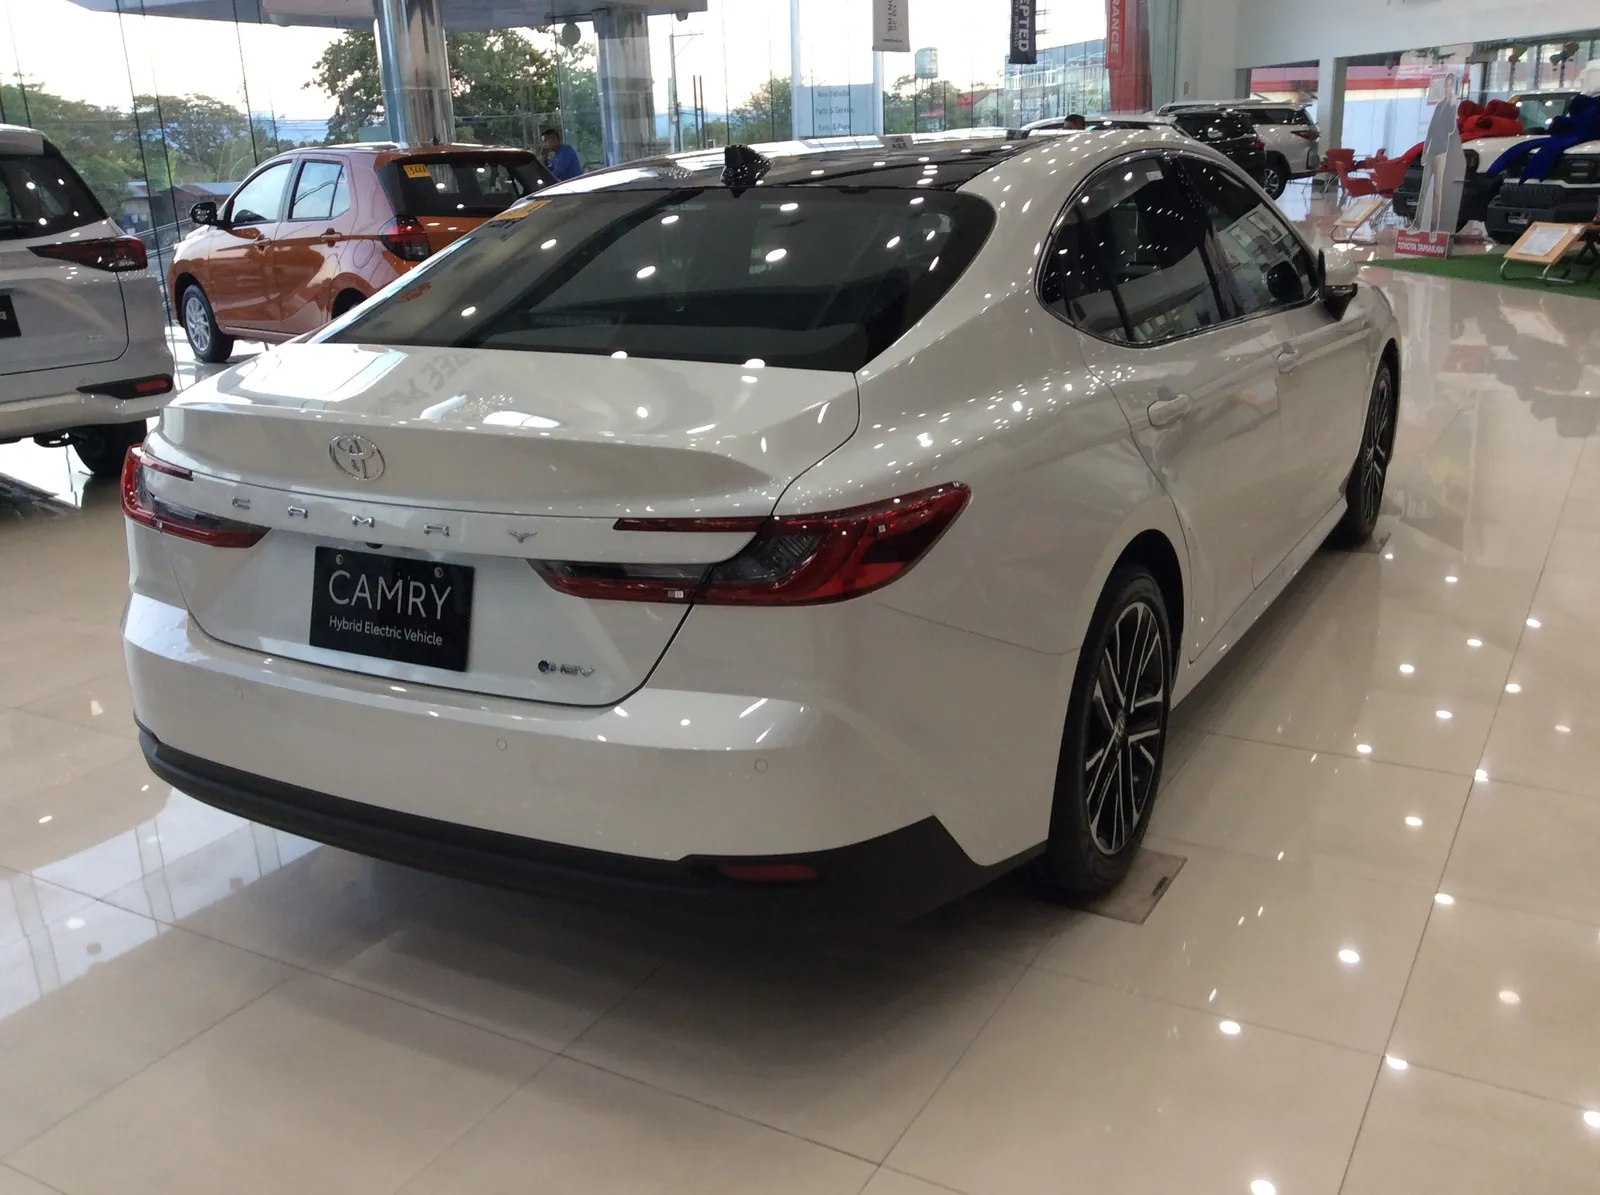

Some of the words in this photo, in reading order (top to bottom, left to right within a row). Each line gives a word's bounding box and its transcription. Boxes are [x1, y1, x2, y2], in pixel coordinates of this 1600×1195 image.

[328, 569, 452, 620] CAMRY
[328, 615, 363, 632] Hybrid
[364, 621, 402, 640] Electric
[403, 627, 443, 646] Vehicle
